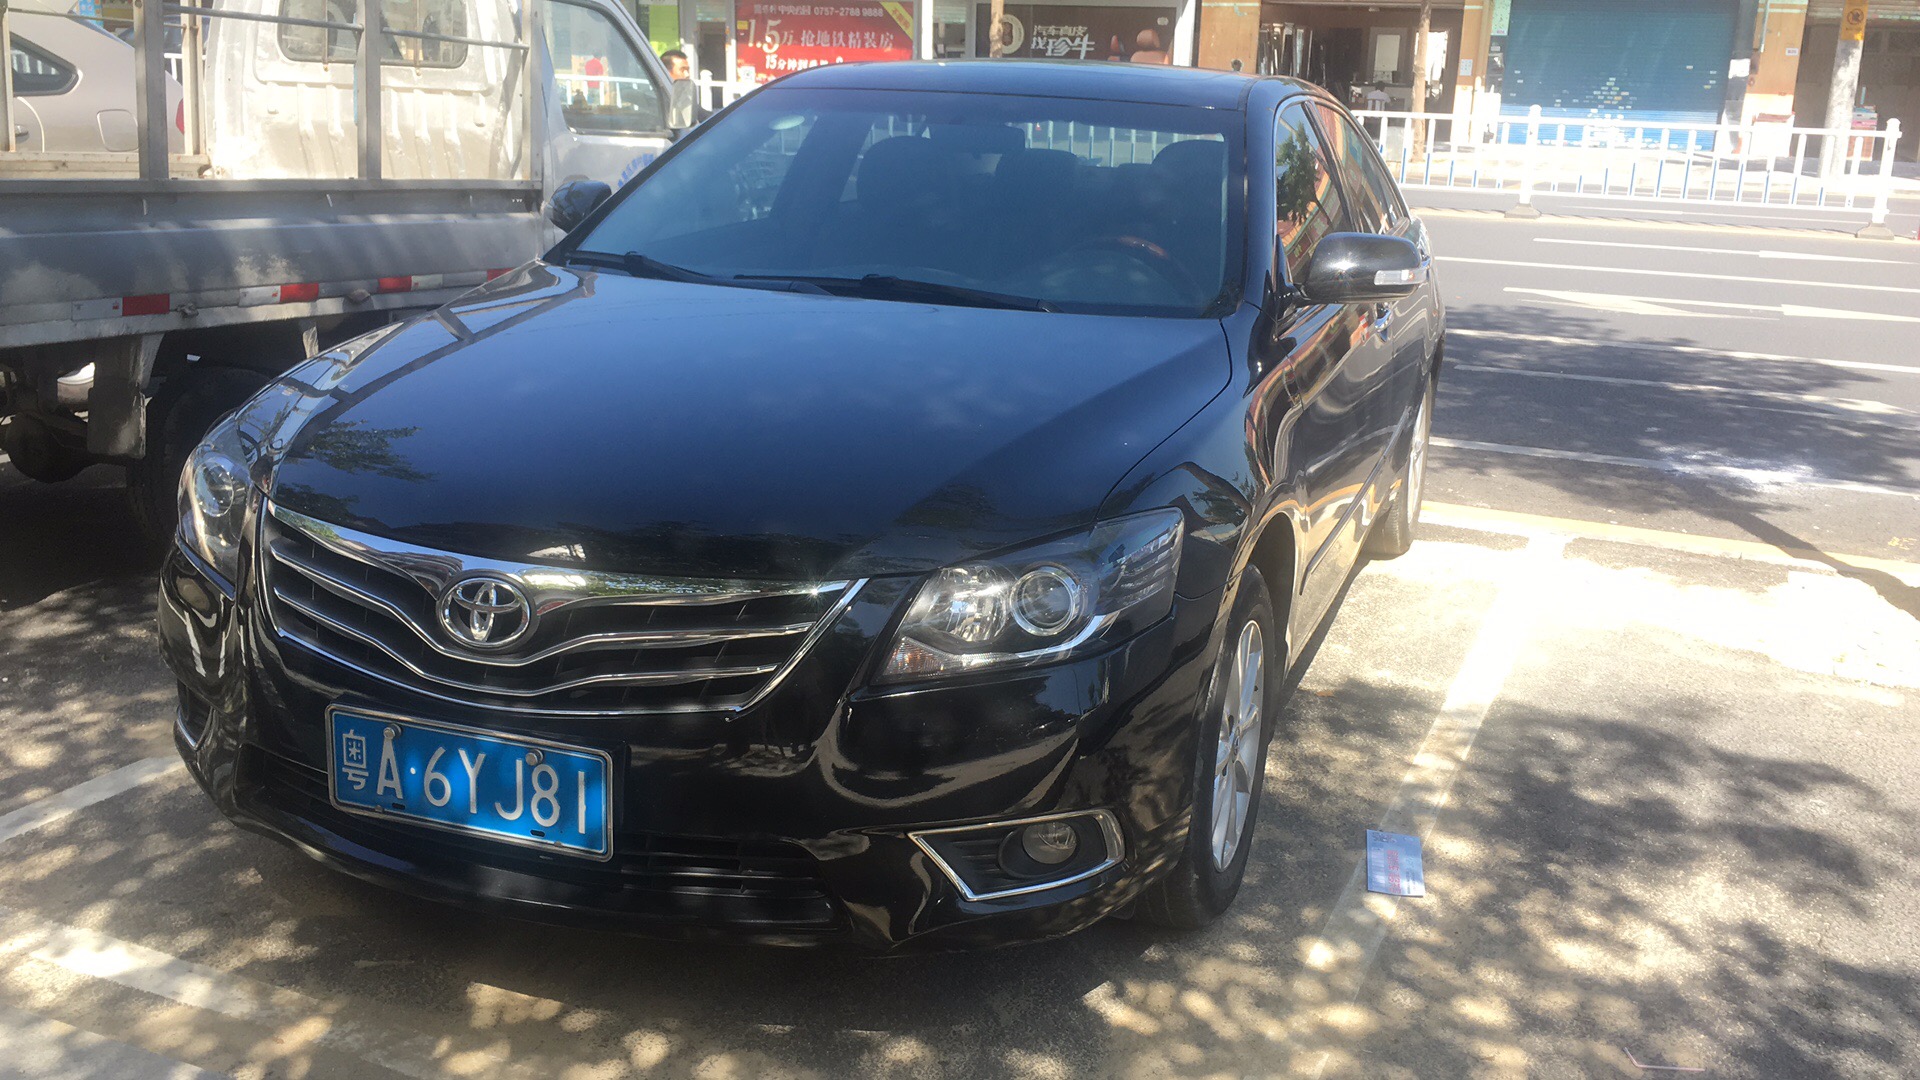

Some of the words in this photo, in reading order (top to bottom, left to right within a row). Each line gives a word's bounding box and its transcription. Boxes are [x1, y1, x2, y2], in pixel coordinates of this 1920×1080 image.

[801, 30, 894, 49] 抢地铁精装房
